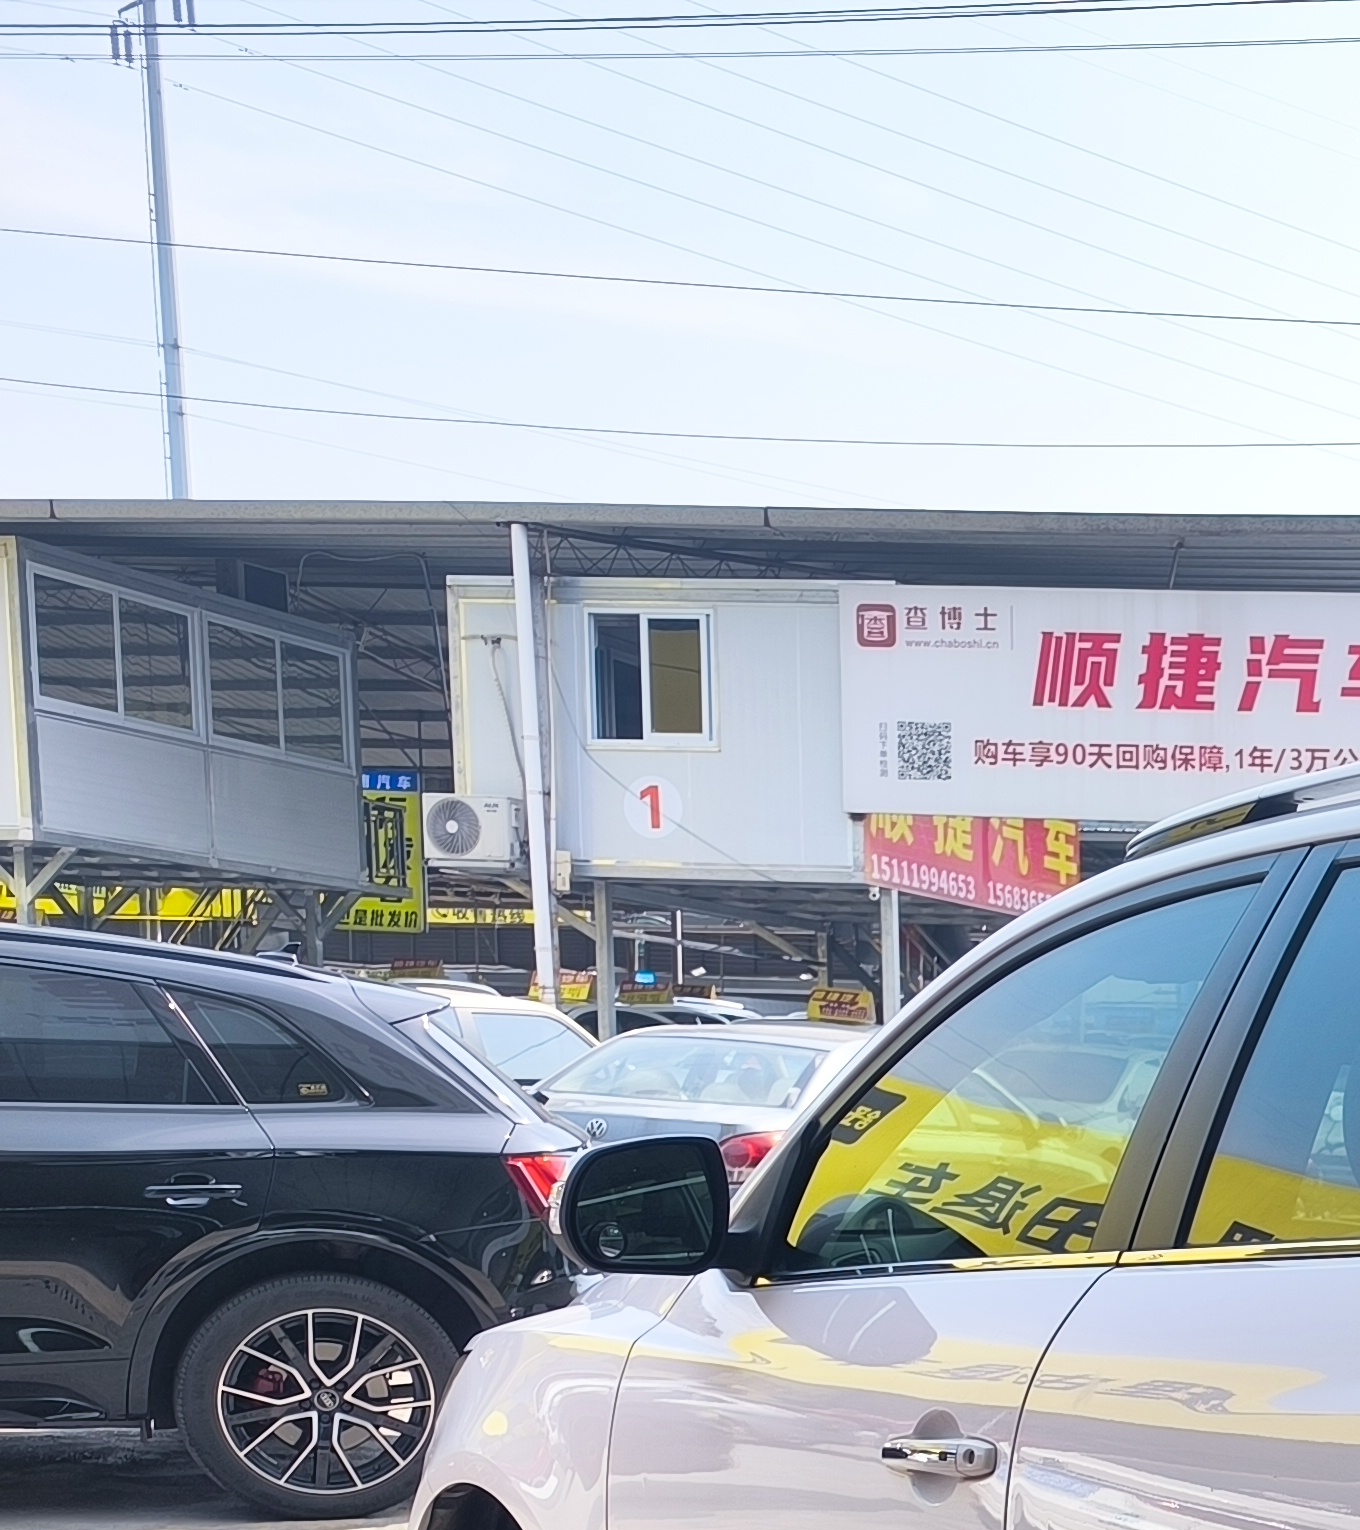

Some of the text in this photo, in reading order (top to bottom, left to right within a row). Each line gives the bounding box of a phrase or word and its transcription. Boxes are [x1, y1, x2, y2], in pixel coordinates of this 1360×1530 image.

[904, 605, 998, 631] 查博士
[904, 638, 1000, 650] www.chaboshi.cn
[638, 784, 662, 830] 1
[871, 853, 1052, 911] 15111994653 1568365
